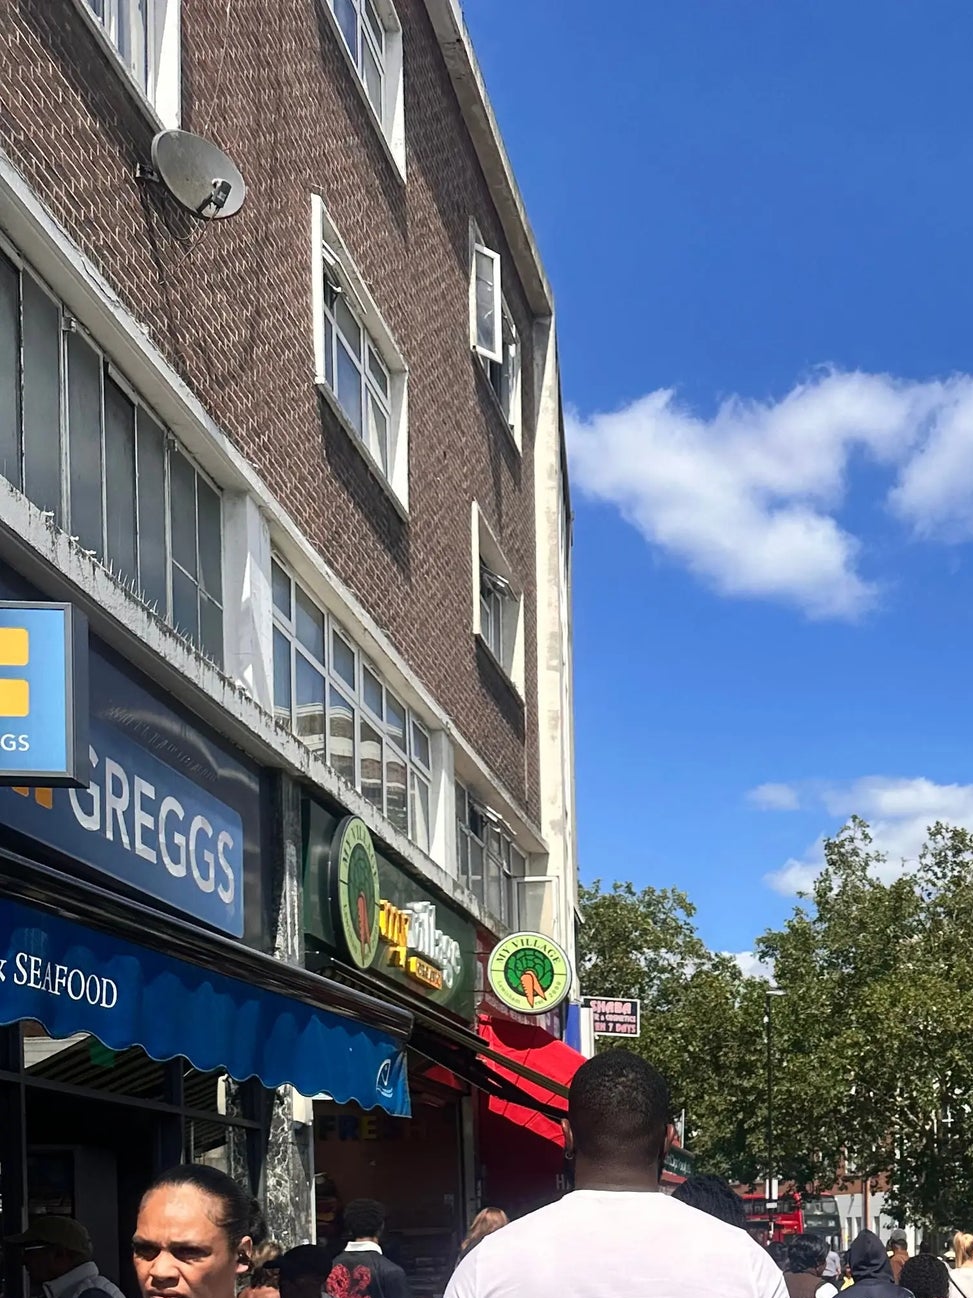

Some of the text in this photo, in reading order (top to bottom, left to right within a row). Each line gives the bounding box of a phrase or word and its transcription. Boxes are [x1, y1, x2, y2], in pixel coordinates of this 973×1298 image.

[68, 744, 235, 904] GREGGS
[496, 938, 561, 964] MY VILLAGE
[13, 952, 118, 1009] SEAFOOD
